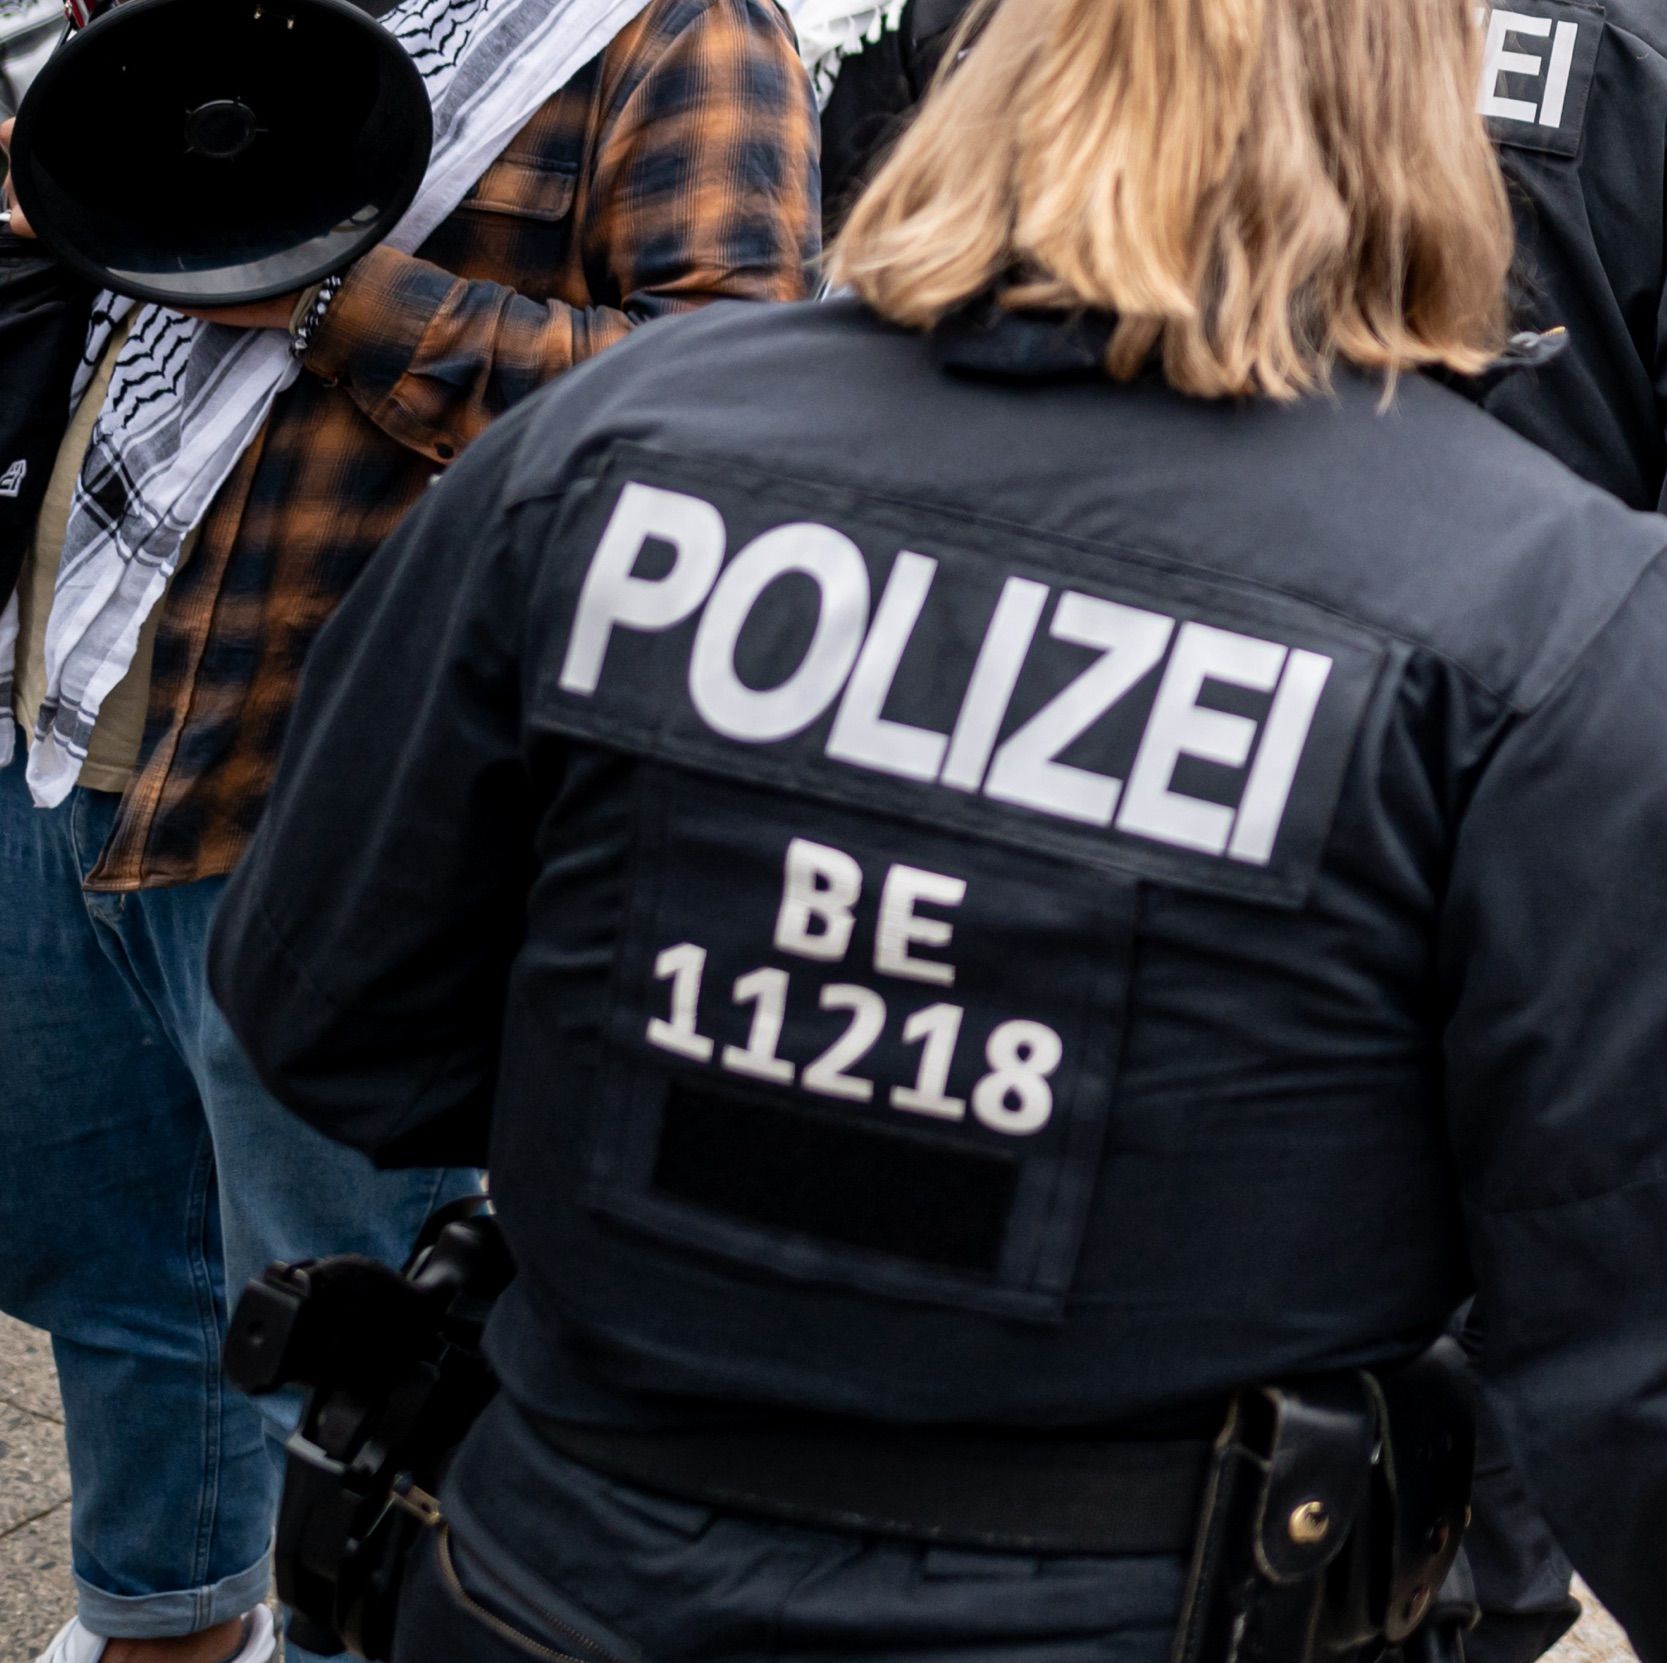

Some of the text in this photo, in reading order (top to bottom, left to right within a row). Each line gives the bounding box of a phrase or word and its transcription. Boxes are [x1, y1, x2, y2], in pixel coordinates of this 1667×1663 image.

[1473, 7, 1579, 129] EI
[559, 481, 1334, 865] POLIZEI
[775, 838, 968, 985] BE
[646, 942, 1063, 1135] 11218
